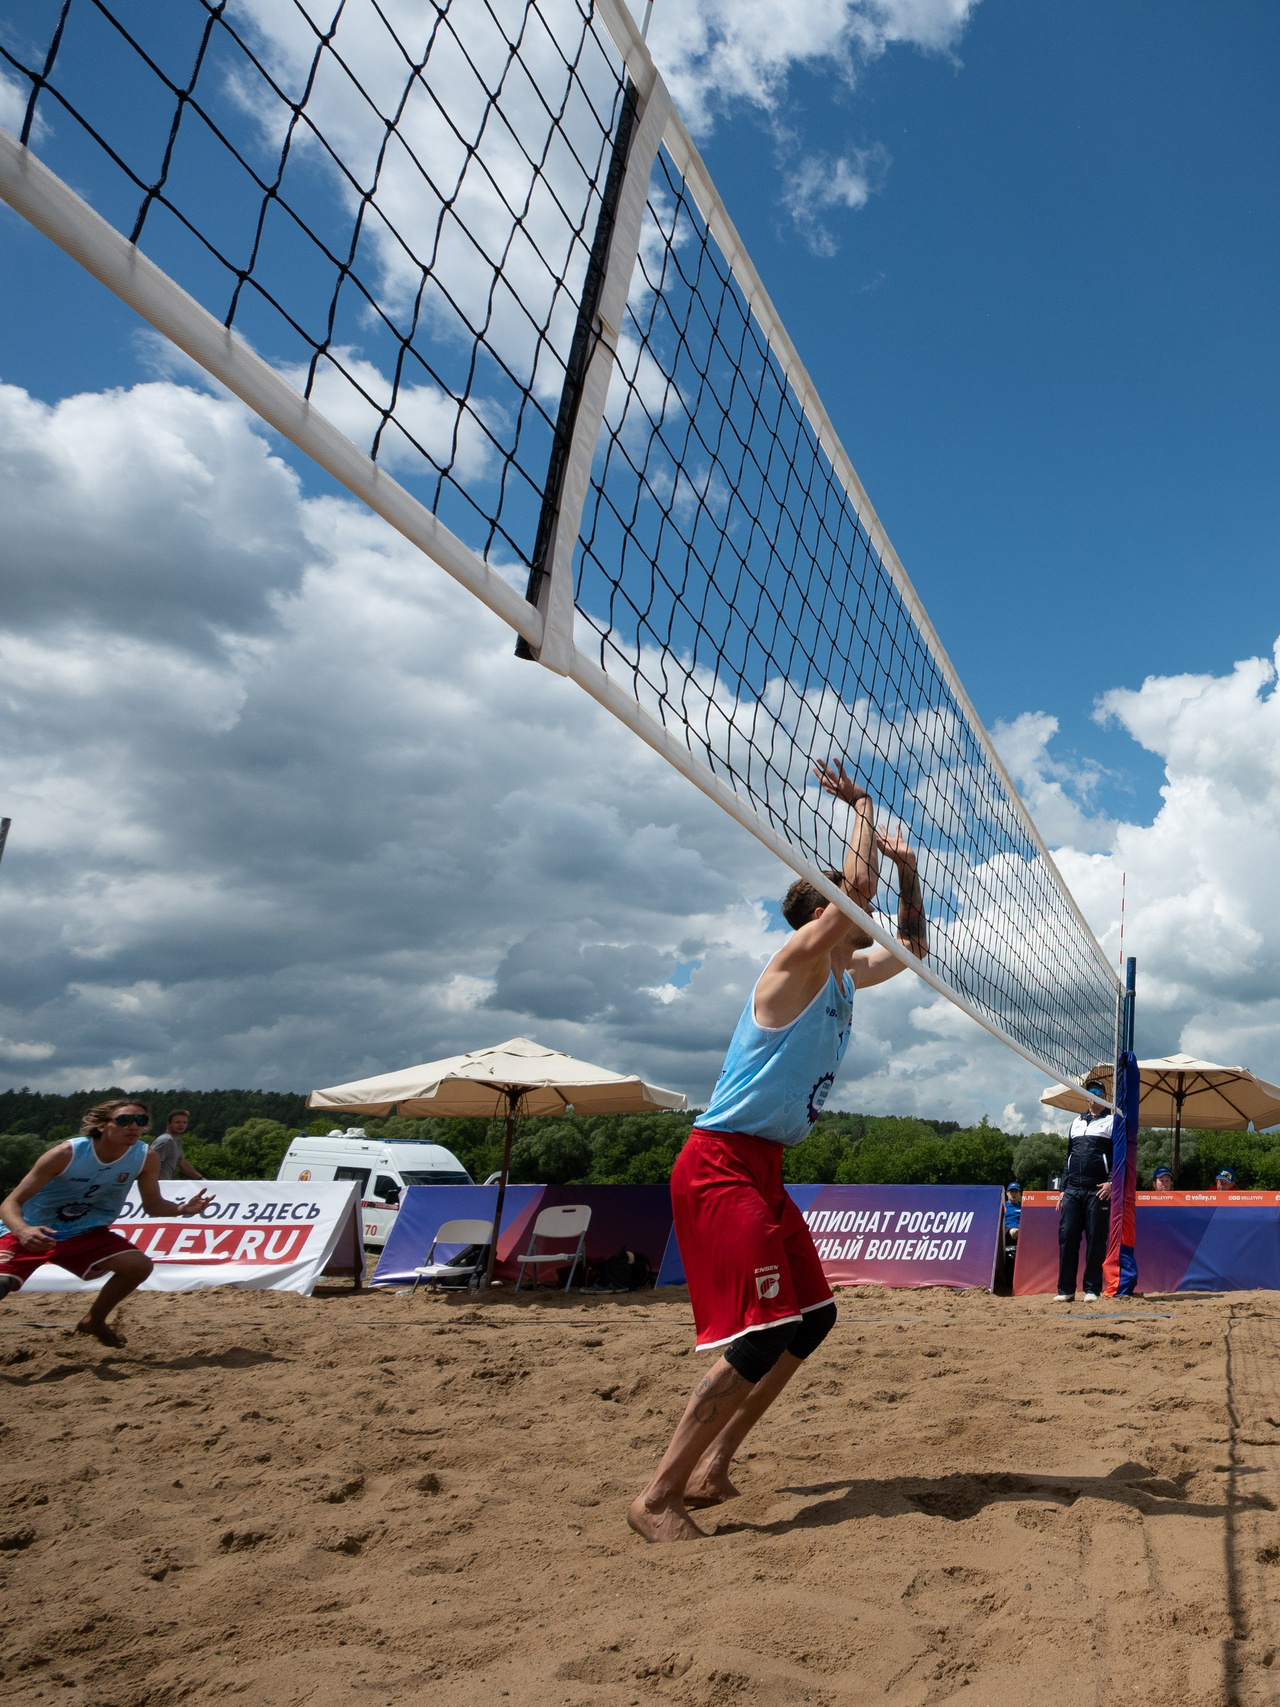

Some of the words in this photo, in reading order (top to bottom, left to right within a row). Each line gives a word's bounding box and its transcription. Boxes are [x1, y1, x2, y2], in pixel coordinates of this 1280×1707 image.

[83, 1184, 100, 1198] 2
[242, 1202, 321, 1222] ЗДЕСЬ
[895, 1211, 974, 1233] РОССИИ
[365, 1224, 377, 1236] 70
[864, 1235, 967, 1261] ВОЛЕЙБОЛ
